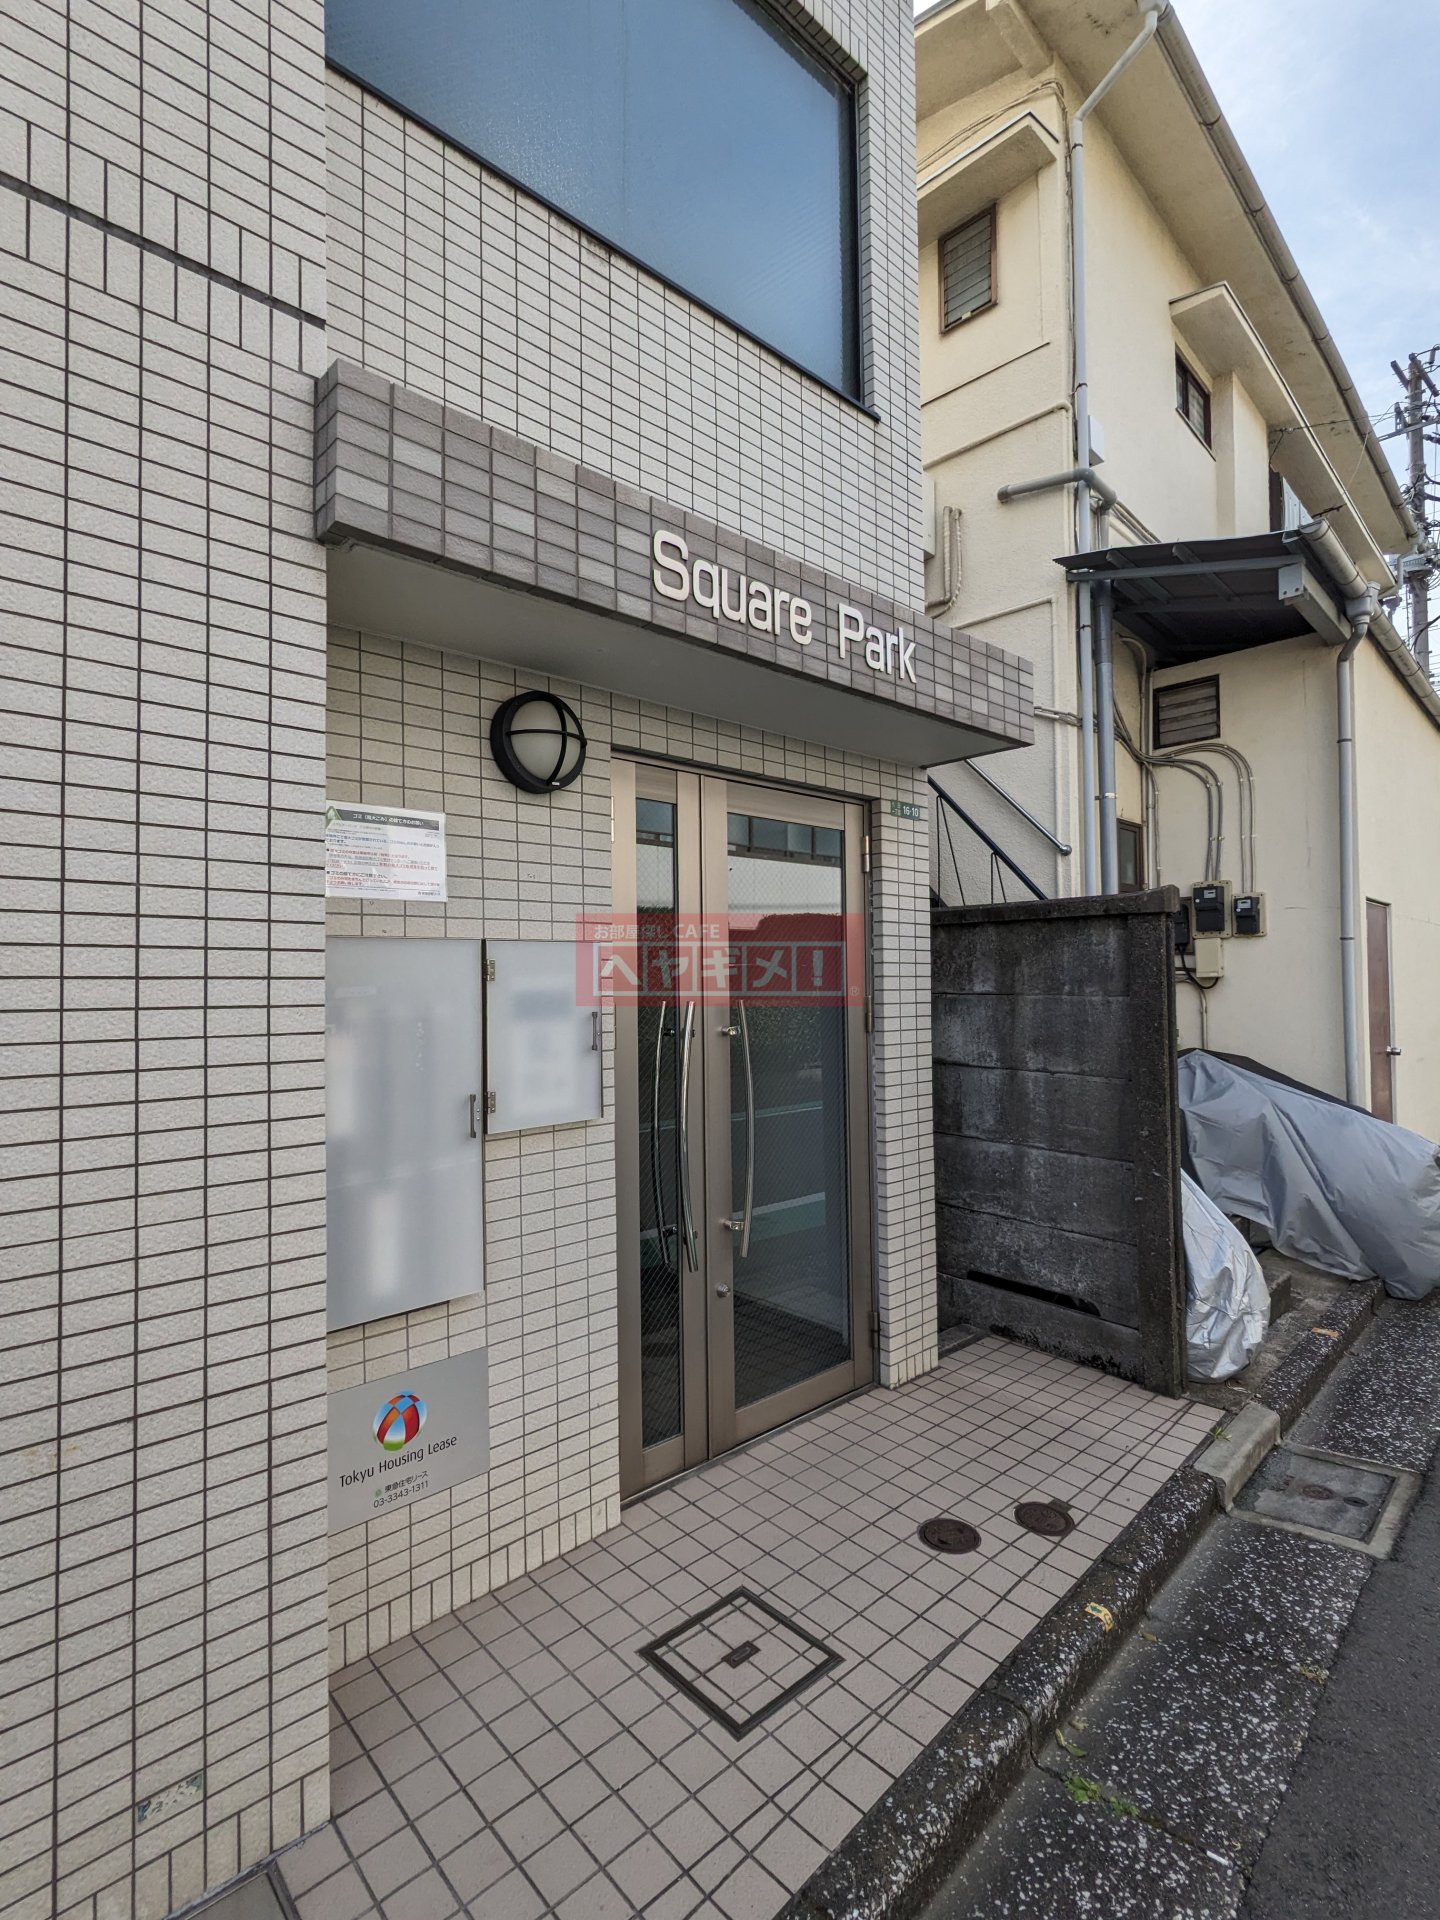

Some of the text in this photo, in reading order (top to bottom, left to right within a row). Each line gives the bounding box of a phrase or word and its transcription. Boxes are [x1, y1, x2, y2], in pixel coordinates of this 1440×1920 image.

[653, 529, 917, 684] Square Park
[339, 1435, 458, 1488] Tokyu Housing Lease
[384, 1470, 429, 1493] 東急住宅リース
[373, 1480, 429, 1508] 03-3343-1311
